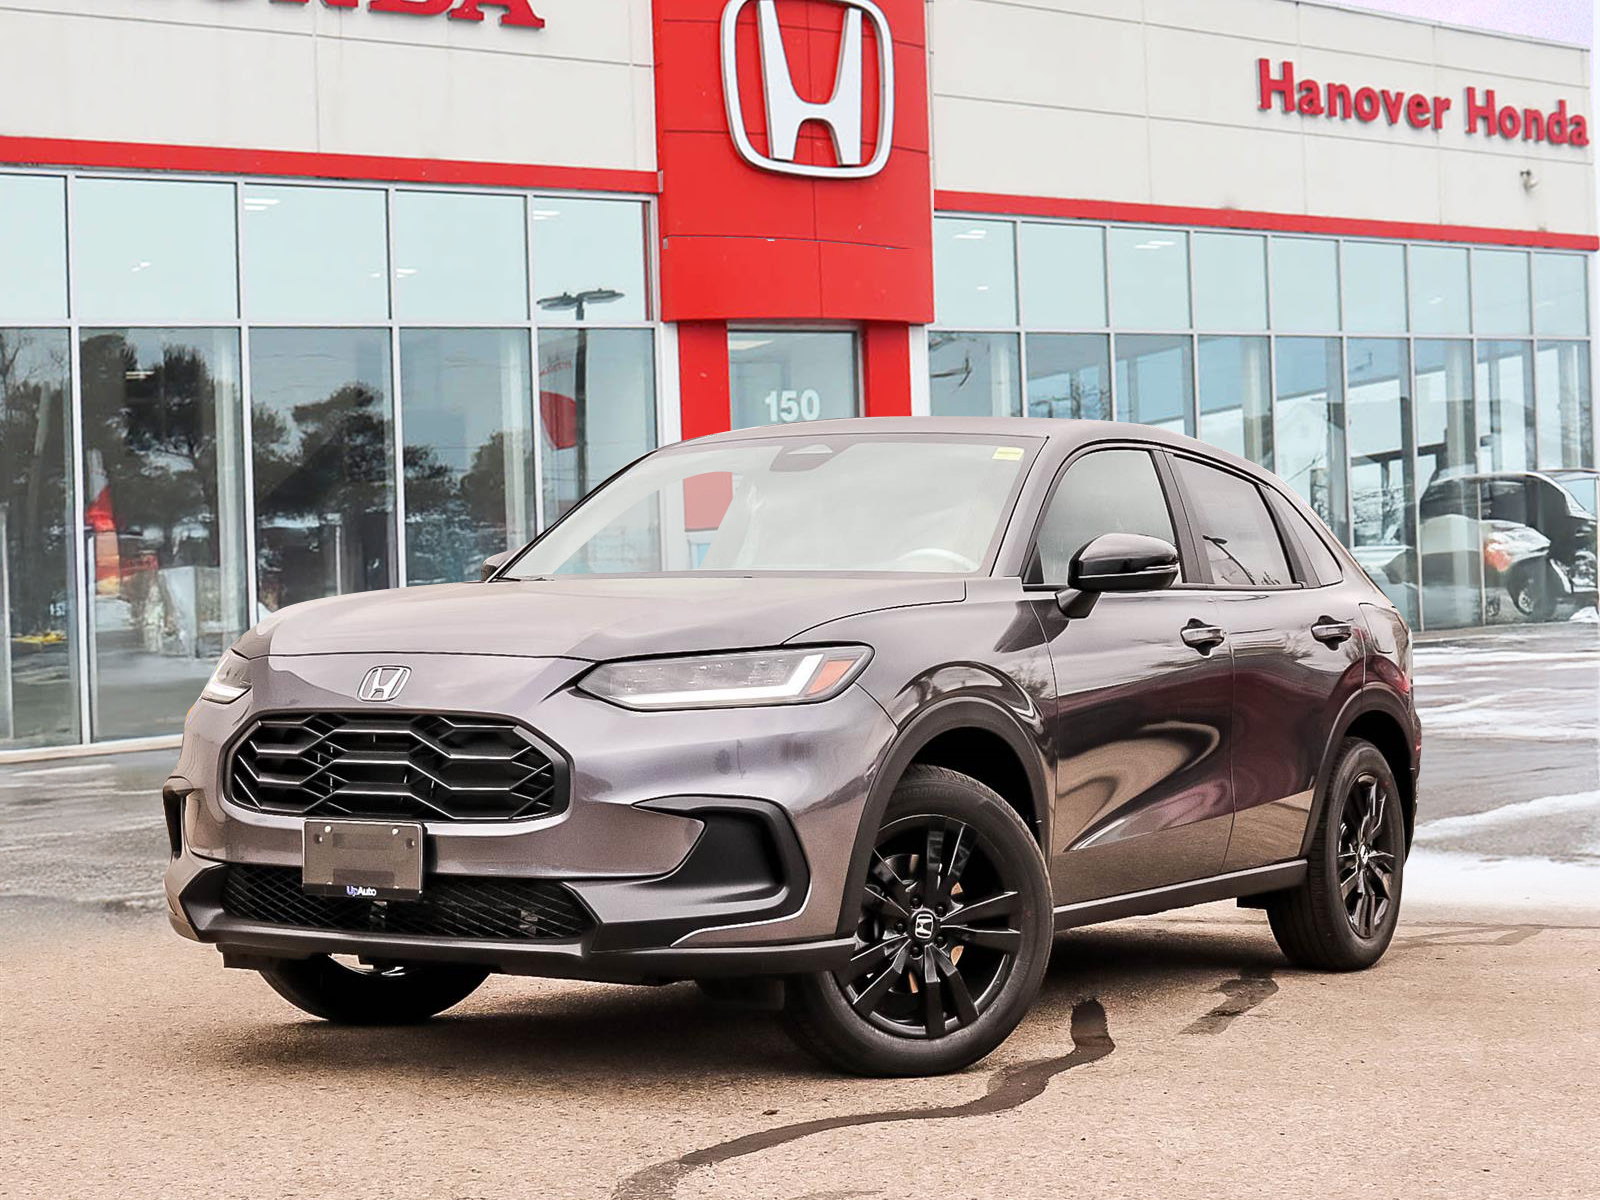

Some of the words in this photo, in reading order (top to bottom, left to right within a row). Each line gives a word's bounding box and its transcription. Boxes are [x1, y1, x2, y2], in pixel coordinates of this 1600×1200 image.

[1258, 57, 1452, 131] Hanover
[1464, 86, 1590, 147] Honda
[764, 388, 821, 422] 150
[346, 885, 377, 897] UpAuto
